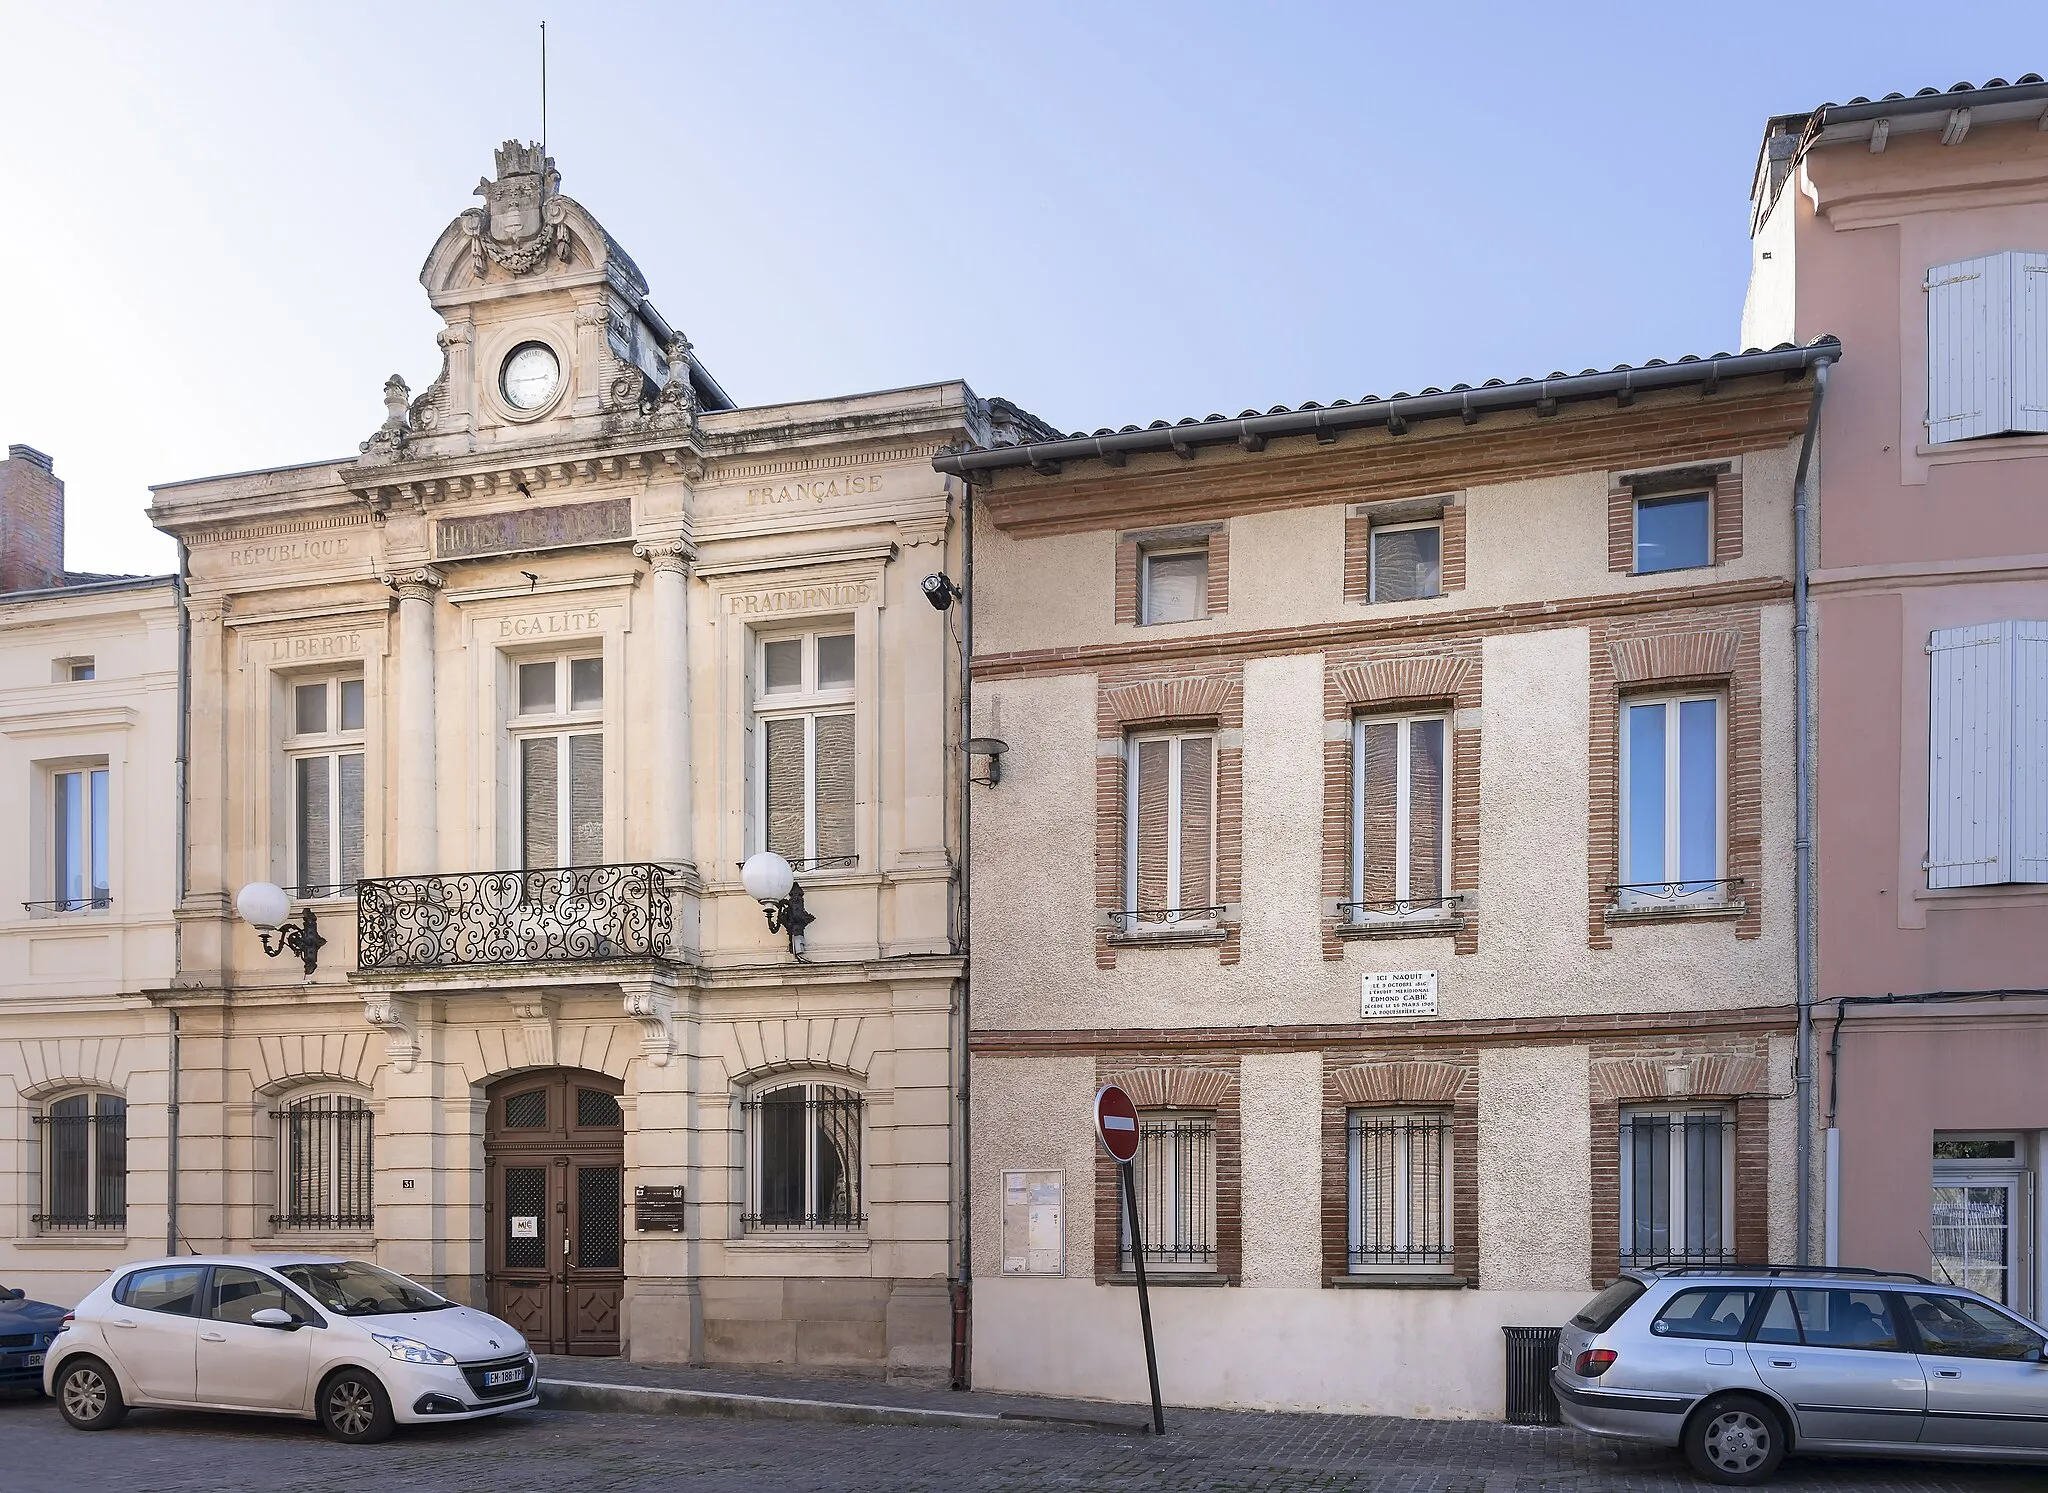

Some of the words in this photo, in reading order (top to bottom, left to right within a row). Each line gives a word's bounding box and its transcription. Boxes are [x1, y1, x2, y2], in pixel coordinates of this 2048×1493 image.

[747, 473, 883, 506] FRANÇAISE
[230, 538, 349, 566] RÉPUBLIQUE
[730, 581, 870, 615] FRATERNITÉ
[500, 609, 600, 637] ÉGALITÉ
[272, 630, 361, 660] LIBERTÉ
[1403, 993, 1428, 1001] CABIÉ
[30, 1355, 45, 1366] BR-
